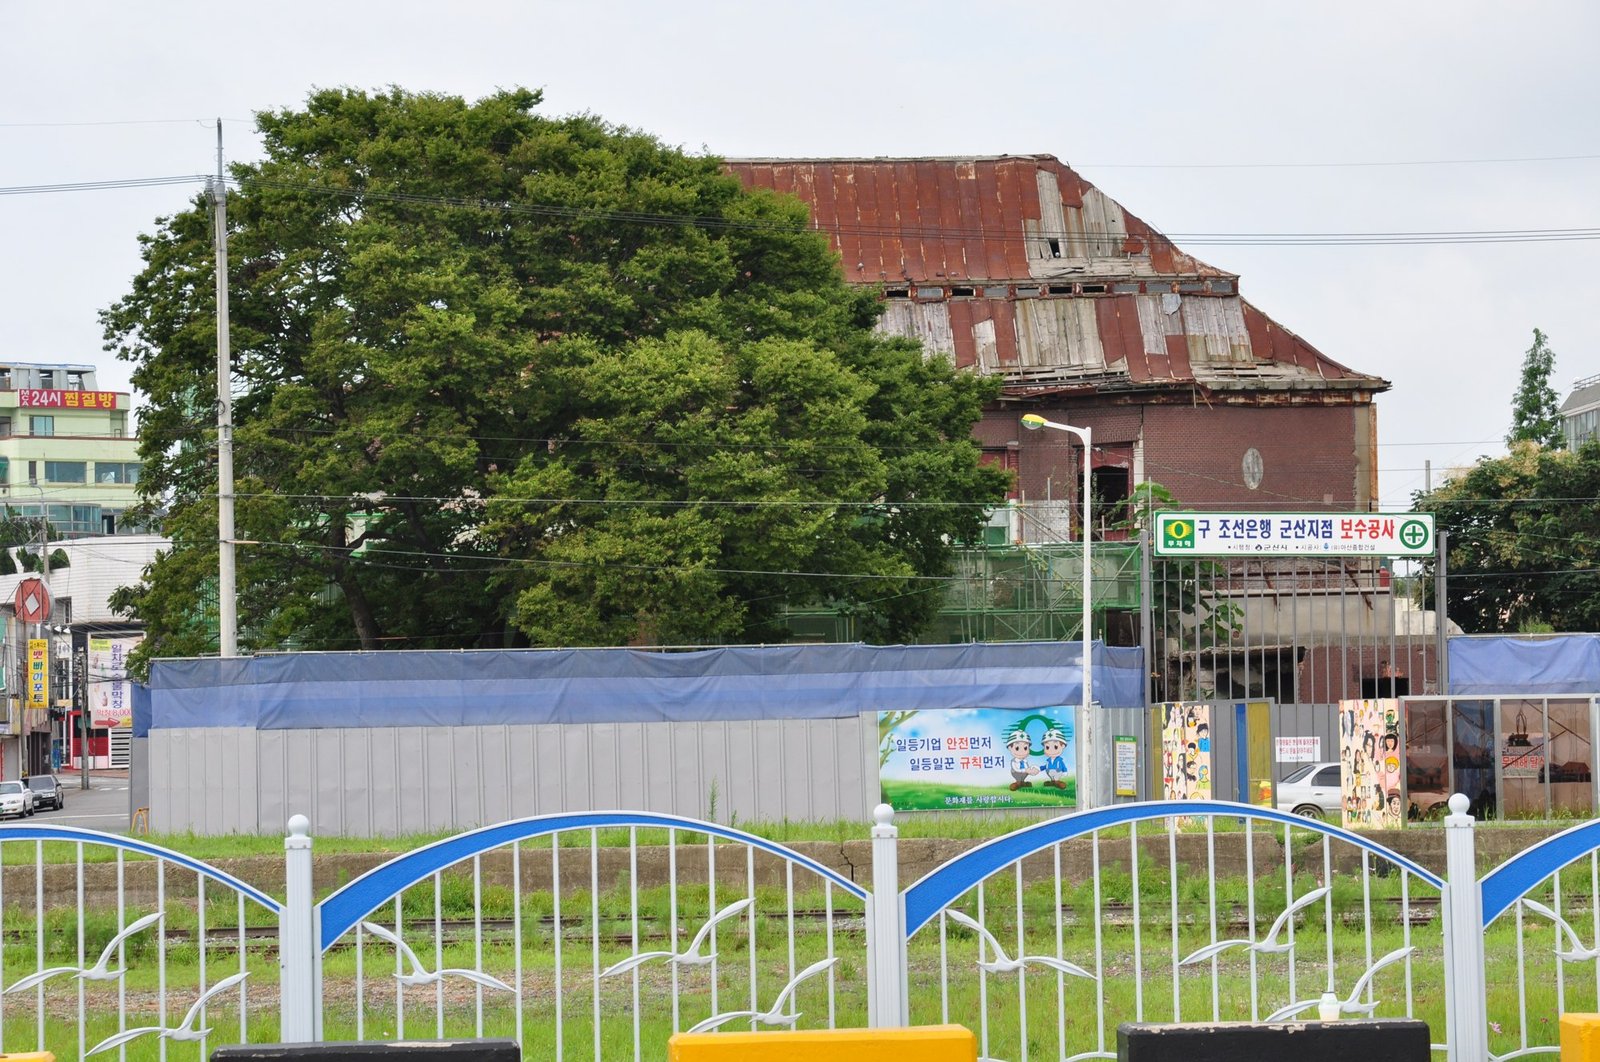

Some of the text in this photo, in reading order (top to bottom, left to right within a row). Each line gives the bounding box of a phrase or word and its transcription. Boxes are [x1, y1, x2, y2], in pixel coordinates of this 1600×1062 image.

[21, 390, 30, 406] MCA
[32, 390, 114, 408] 24시 찜질방
[1198, 519, 1211, 539] 구
[1218, 519, 1272, 539] 조선은행
[1279, 519, 1333, 539] 군산지점
[1341, 519, 1395, 540] 보수공사
[896, 736, 992, 752] 일등기업 안전먼저
[909, 755, 1006, 771] 일등일꾼 규칙먼저
